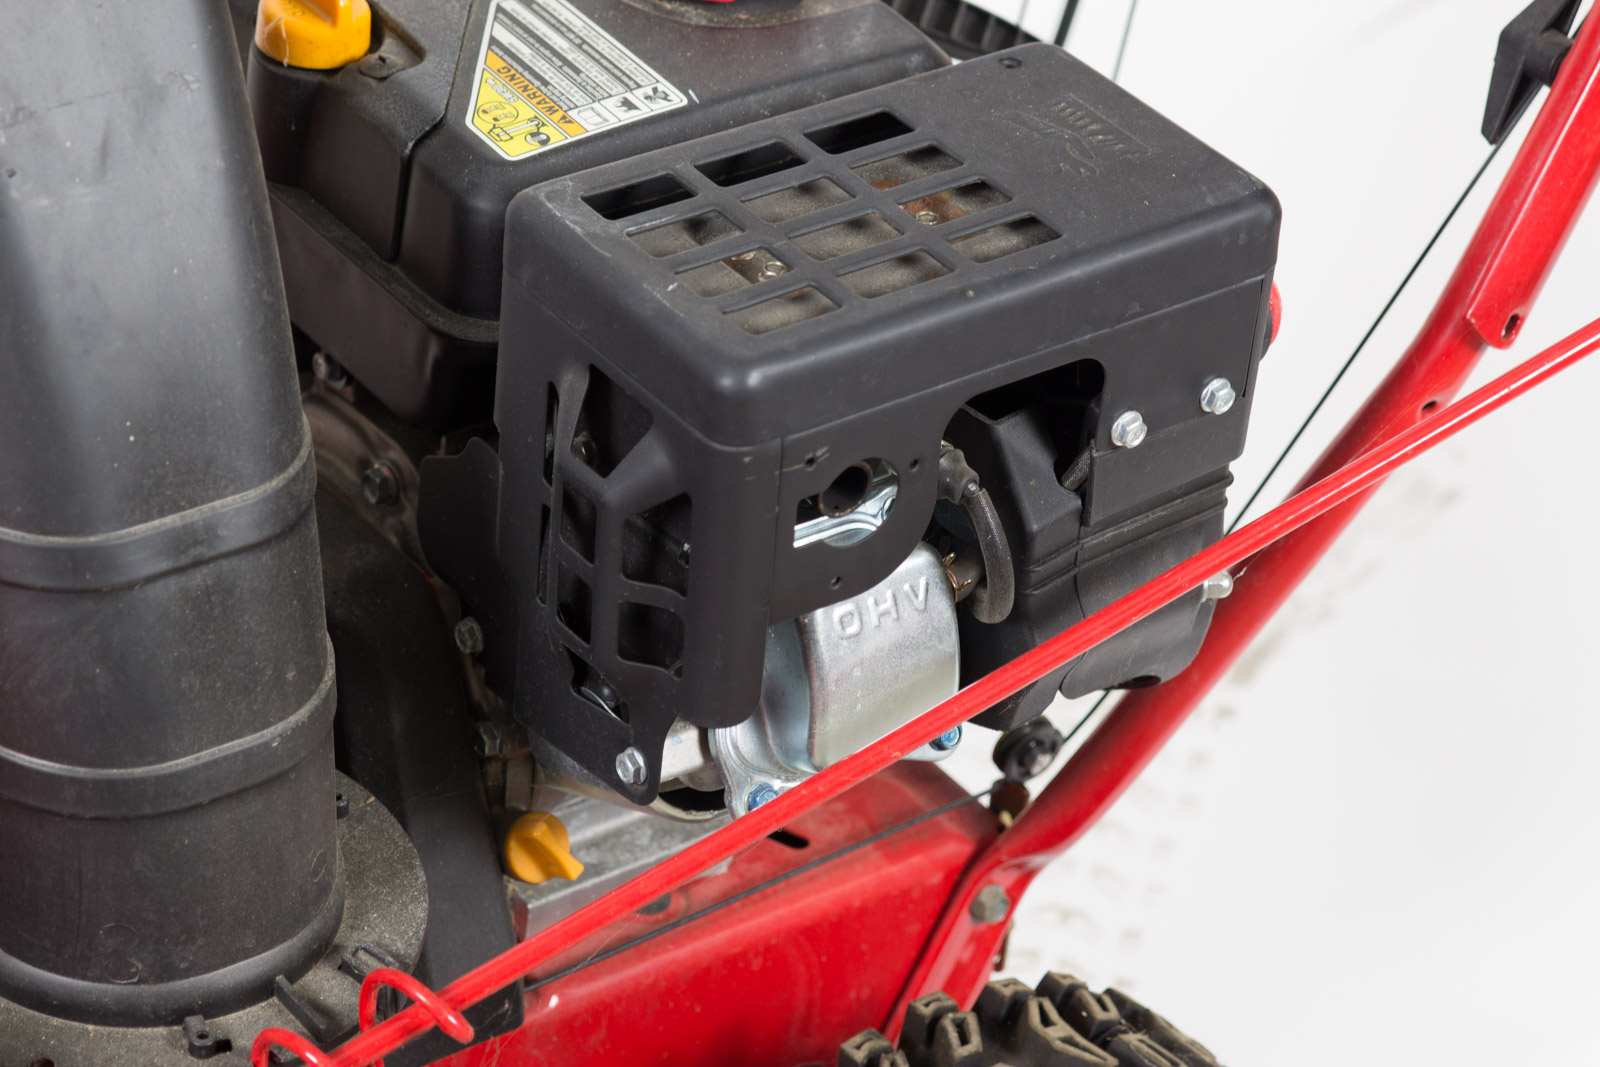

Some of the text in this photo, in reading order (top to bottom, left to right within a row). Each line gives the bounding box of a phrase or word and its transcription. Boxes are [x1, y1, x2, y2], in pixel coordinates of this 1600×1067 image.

[491, 83, 519, 103] 5W30
[495, 65, 560, 115] WARNING
[832, 576, 930, 640] OHV
